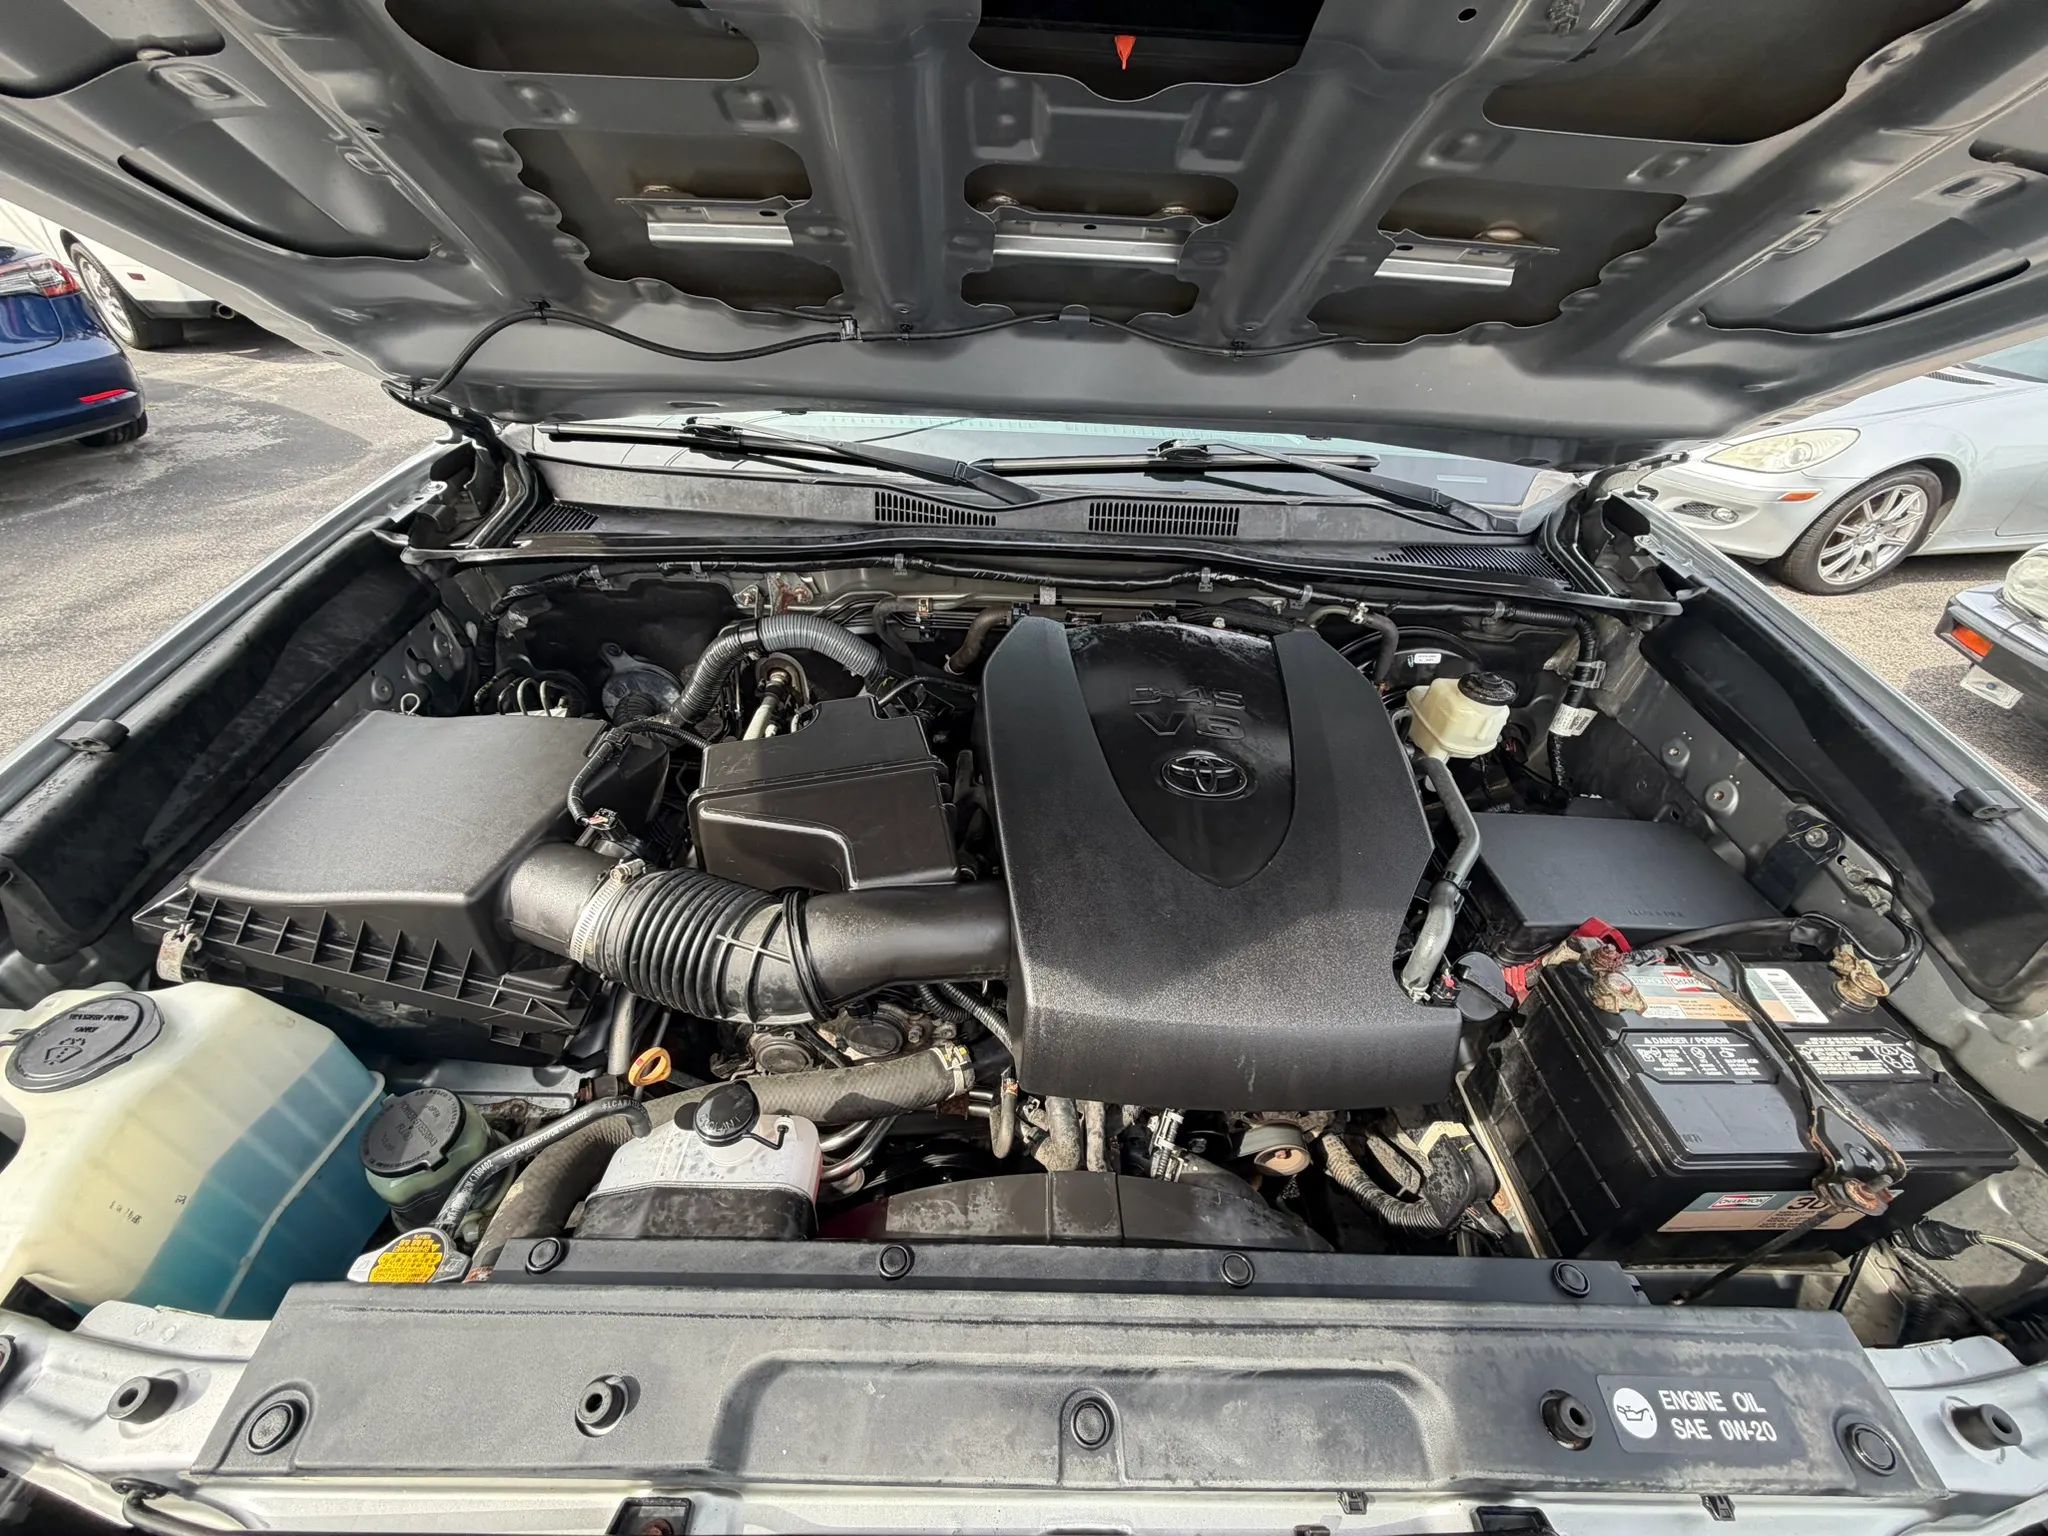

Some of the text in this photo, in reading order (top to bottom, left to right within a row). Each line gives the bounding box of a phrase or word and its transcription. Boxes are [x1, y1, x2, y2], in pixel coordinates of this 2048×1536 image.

[1136, 711, 1246, 740] V6
[1652, 1036, 1688, 1044] DANGER
[1695, 1036, 1730, 1044] POISON
[1658, 1389, 1767, 1413] ENGINE OIL
[1671, 1418, 1778, 1442] SAE 0W-20
